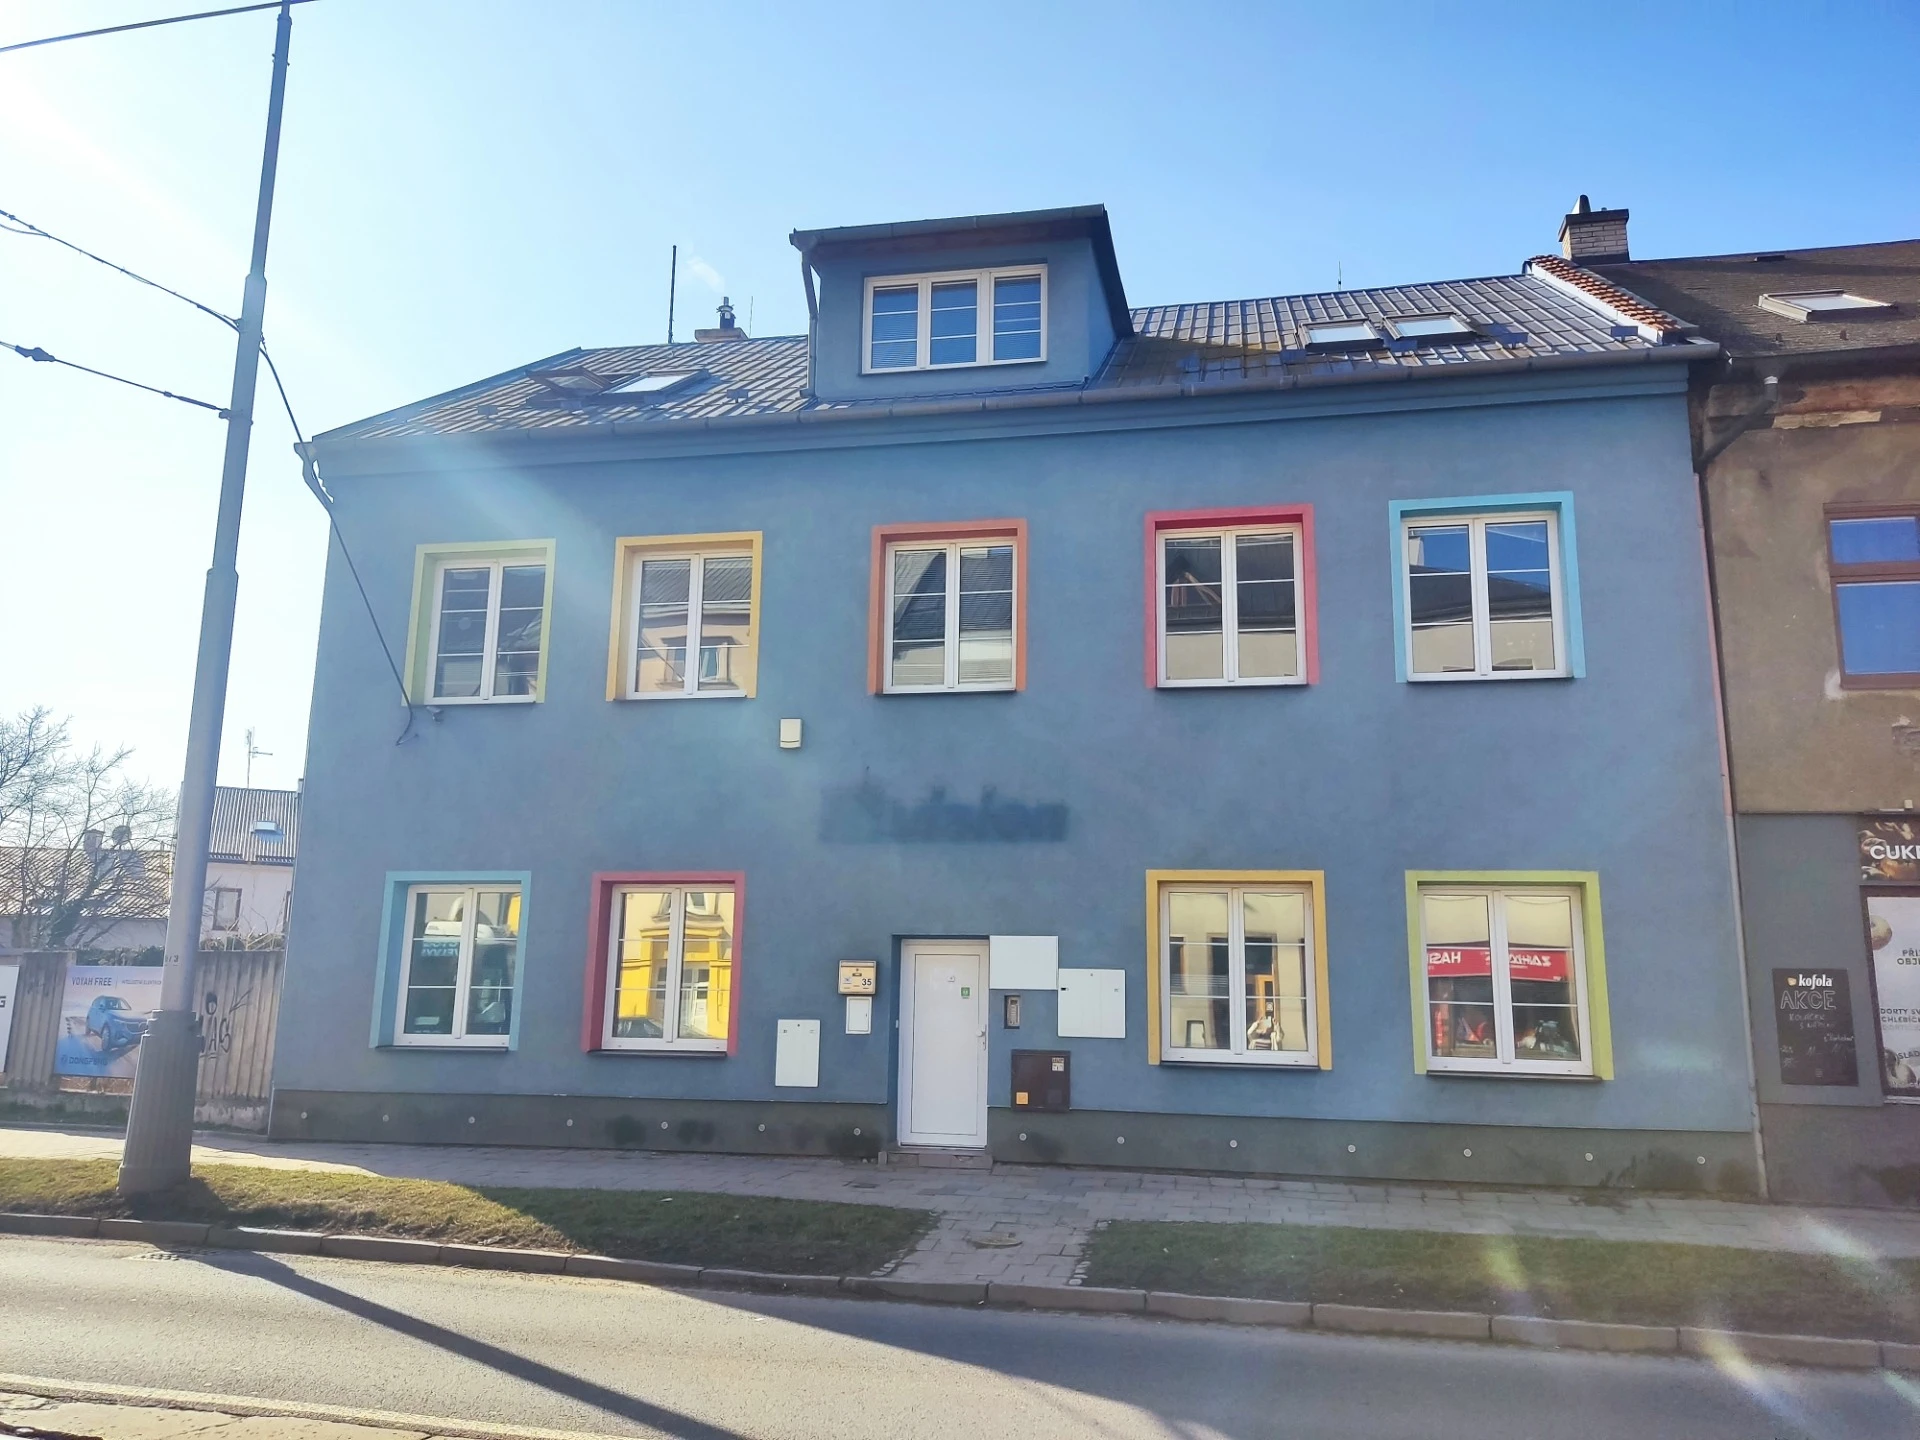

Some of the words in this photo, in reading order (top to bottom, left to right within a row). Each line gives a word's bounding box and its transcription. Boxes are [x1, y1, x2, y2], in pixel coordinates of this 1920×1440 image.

[71, 976, 93, 986] VOYAH
[94, 976, 113, 986] FREE
[861, 978, 873, 986] 35
[1798, 974, 1833, 990] kofola
[1780, 990, 1837, 1011] AKCE
